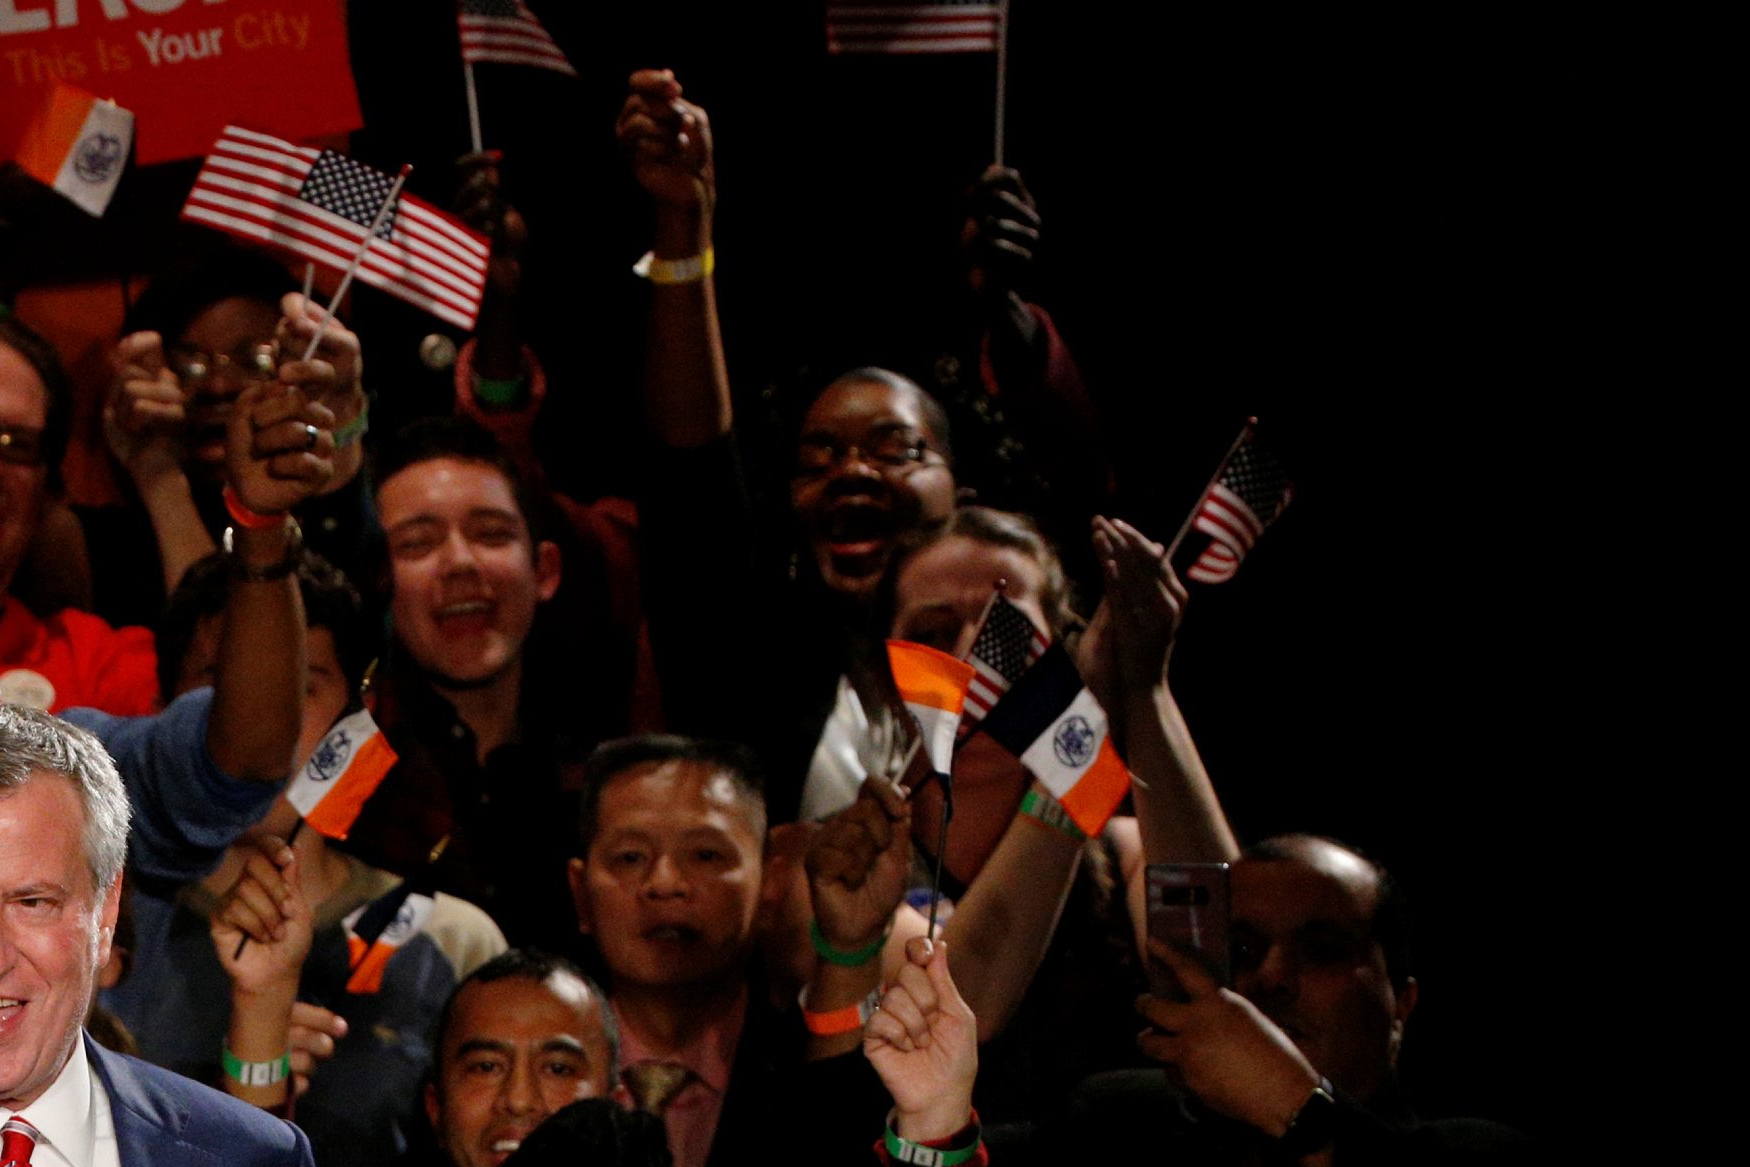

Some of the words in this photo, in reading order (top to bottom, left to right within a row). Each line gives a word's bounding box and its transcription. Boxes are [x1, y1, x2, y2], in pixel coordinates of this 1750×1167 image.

[5, 47, 87, 86] This
[97, 38, 132, 73] Is
[136, 26, 223, 67] Your
[233, 11, 311, 52] City
